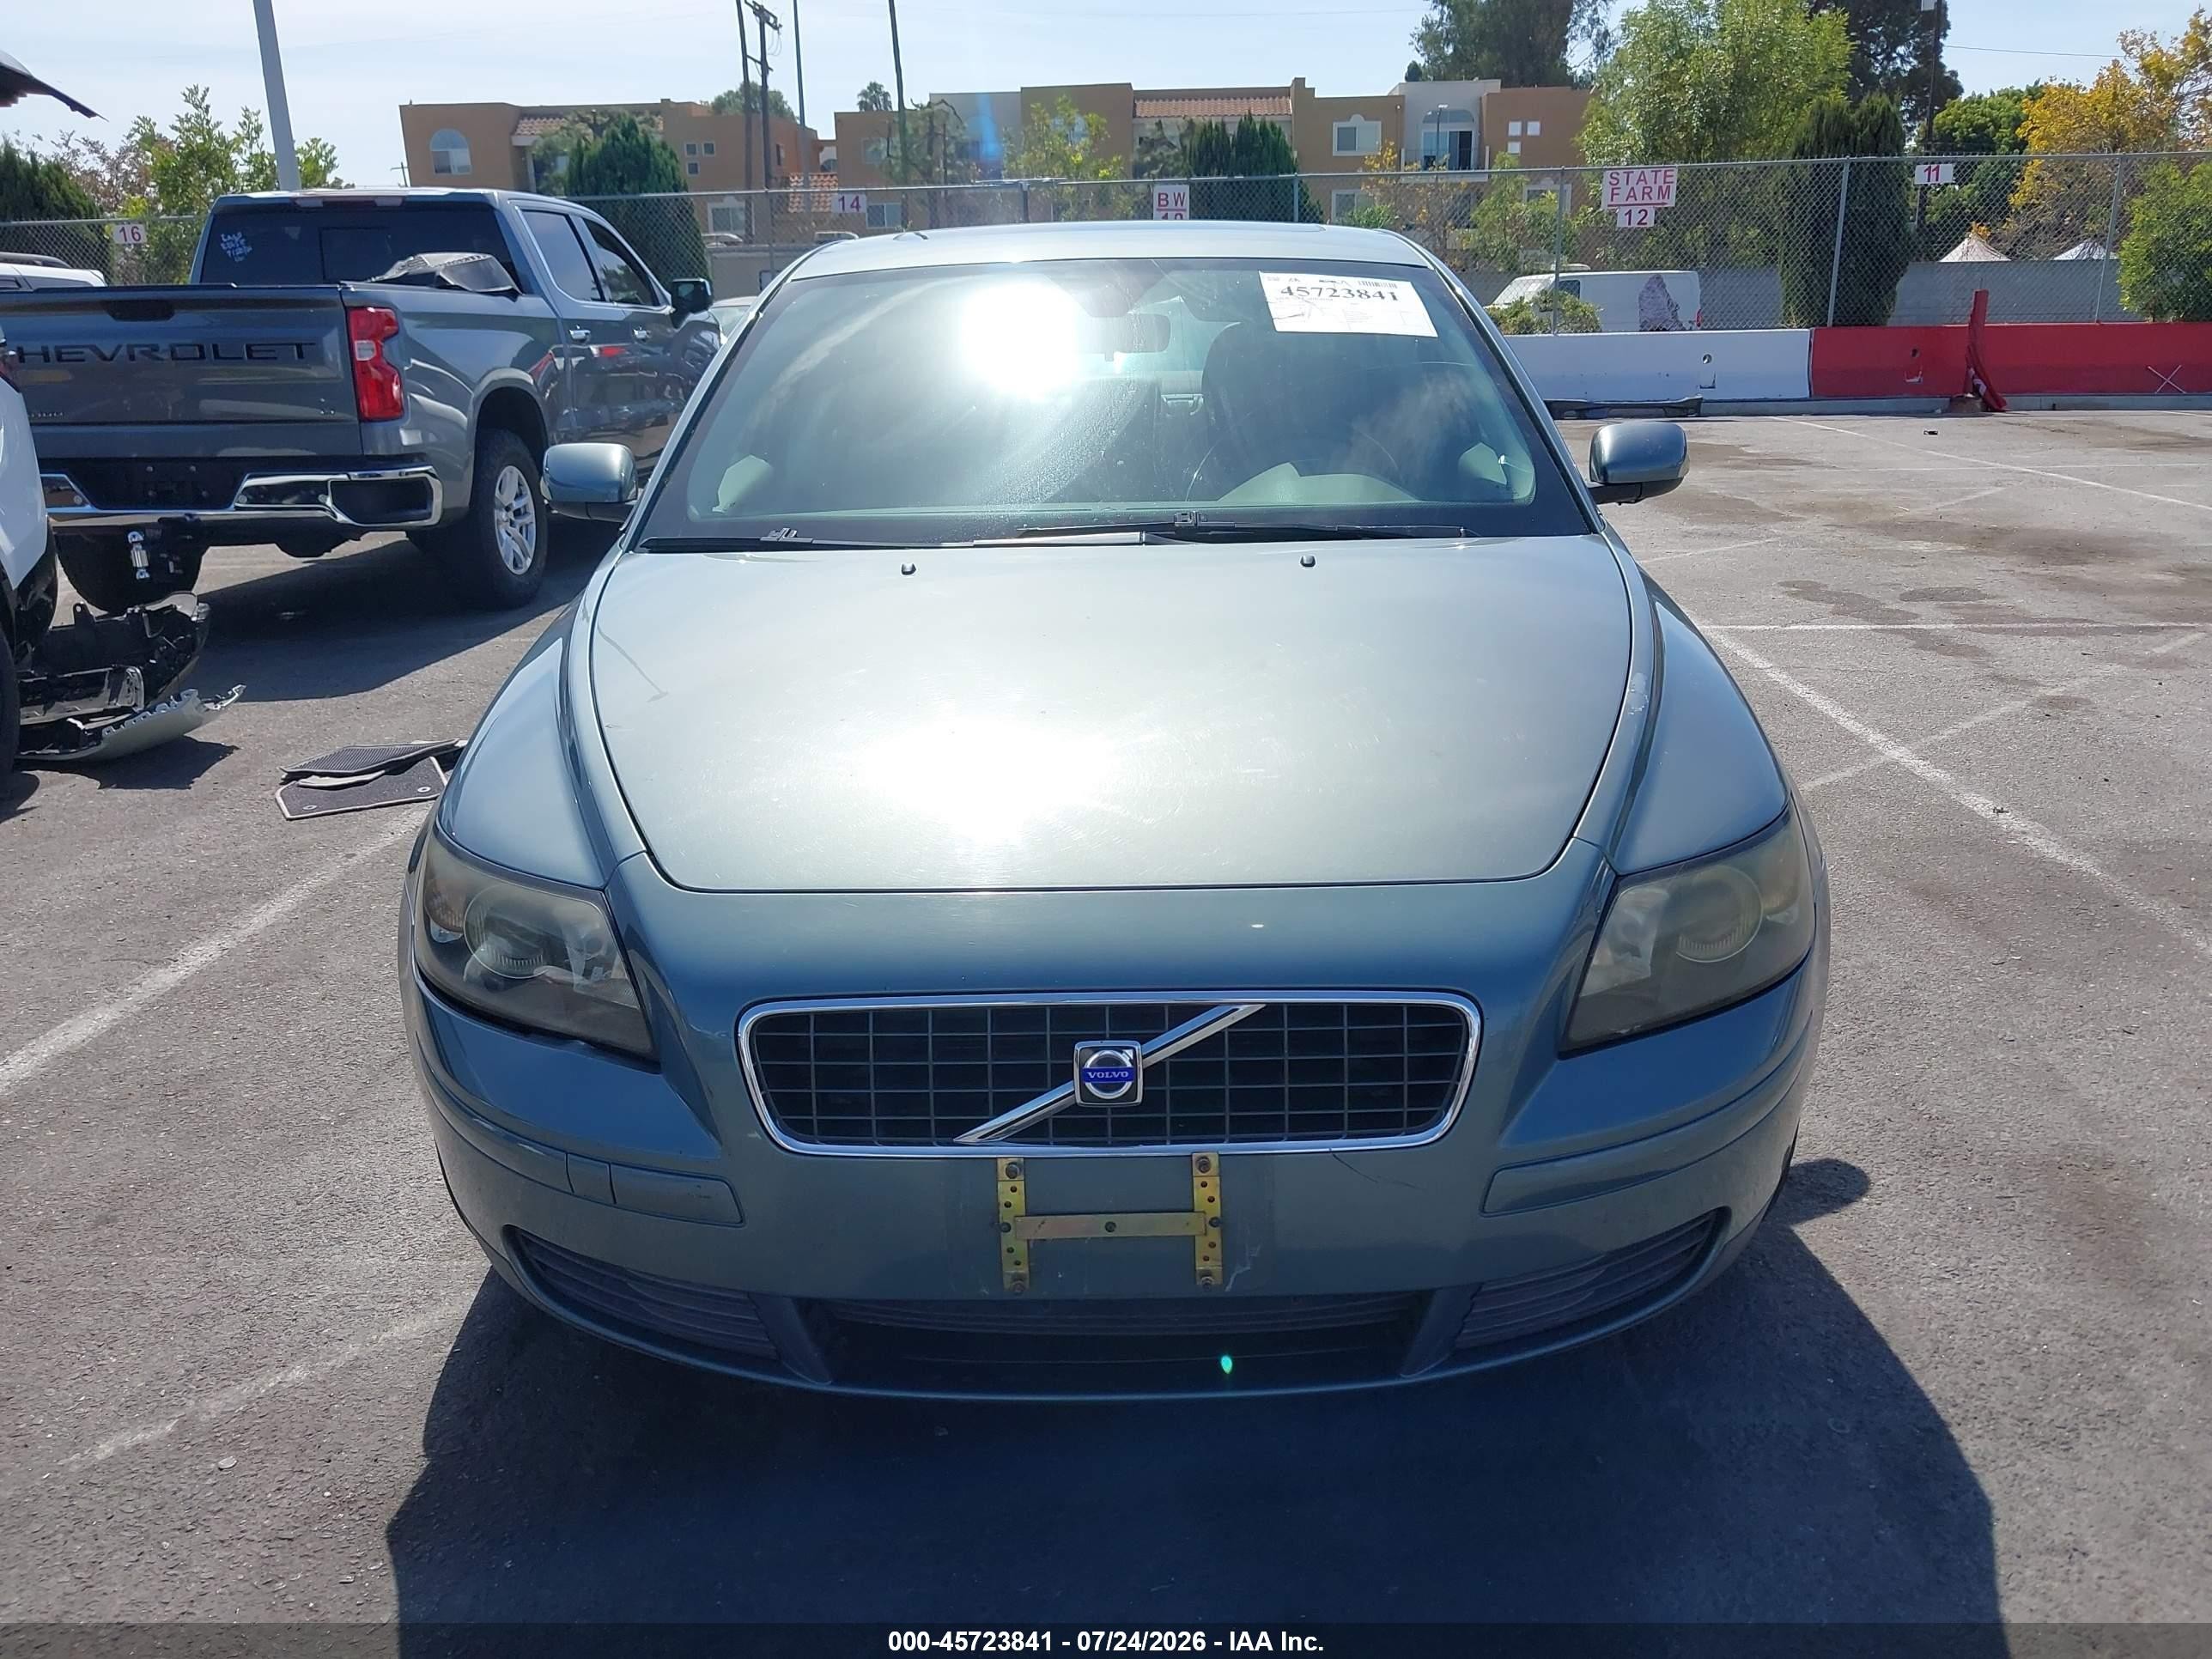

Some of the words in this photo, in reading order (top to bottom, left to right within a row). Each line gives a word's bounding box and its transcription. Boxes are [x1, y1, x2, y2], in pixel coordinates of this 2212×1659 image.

[1608, 168, 1674, 186] STATE
[1923, 164, 1940, 183] 11
[1158, 191, 1186, 208] BW
[1610, 185, 1671, 203] FARM
[838, 195, 862, 213] 14
[1624, 209, 1649, 227] 12
[118, 226, 142, 242] 16
[1279, 285, 1399, 301] 45723841
[17, 342, 316, 363] HEVROLET
